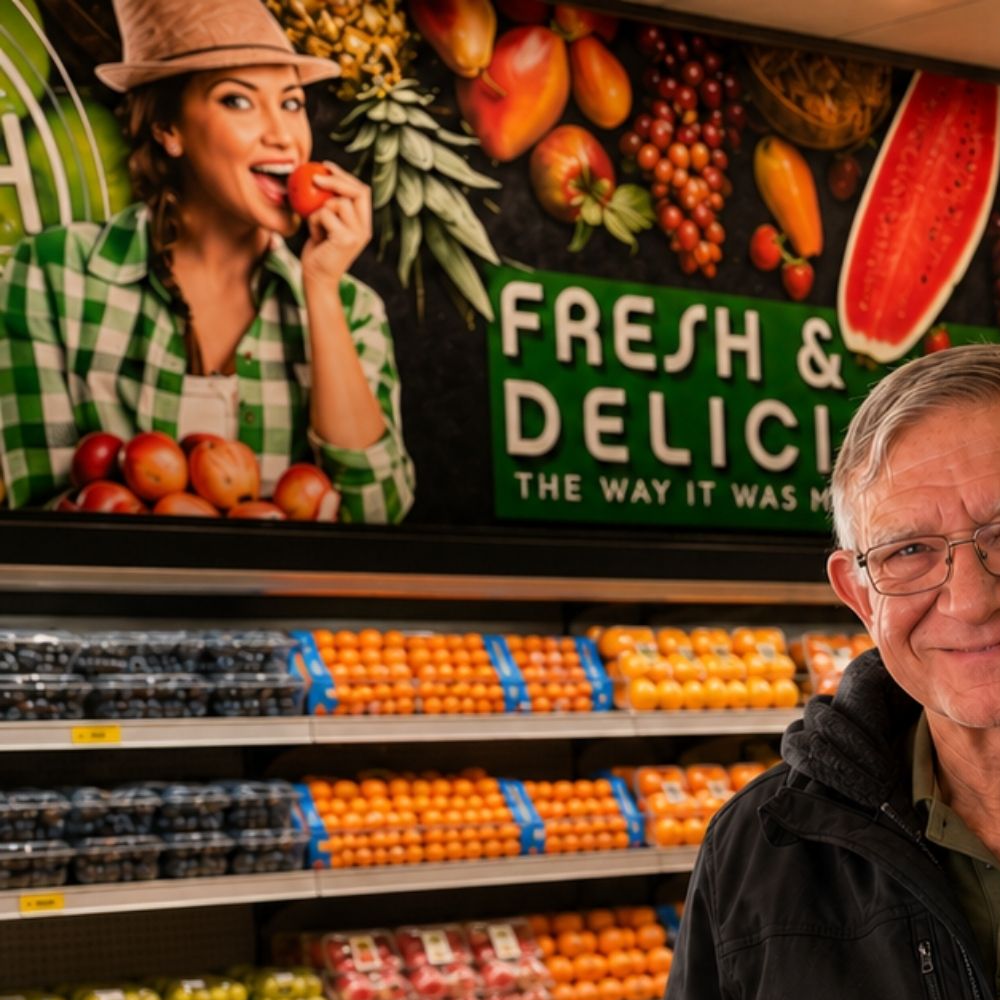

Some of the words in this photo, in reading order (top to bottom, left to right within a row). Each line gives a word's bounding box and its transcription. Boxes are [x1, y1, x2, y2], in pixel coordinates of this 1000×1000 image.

[500, 280, 762, 383] FRESH
[796, 316, 845, 390] &
[503, 378, 832, 474] DELICI
[514, 471, 583, 502] THE
[599, 477, 671, 505] WAY
[686, 480, 717, 508] IT
[730, 483, 798, 512] WAS
[810, 486, 831, 513] M
